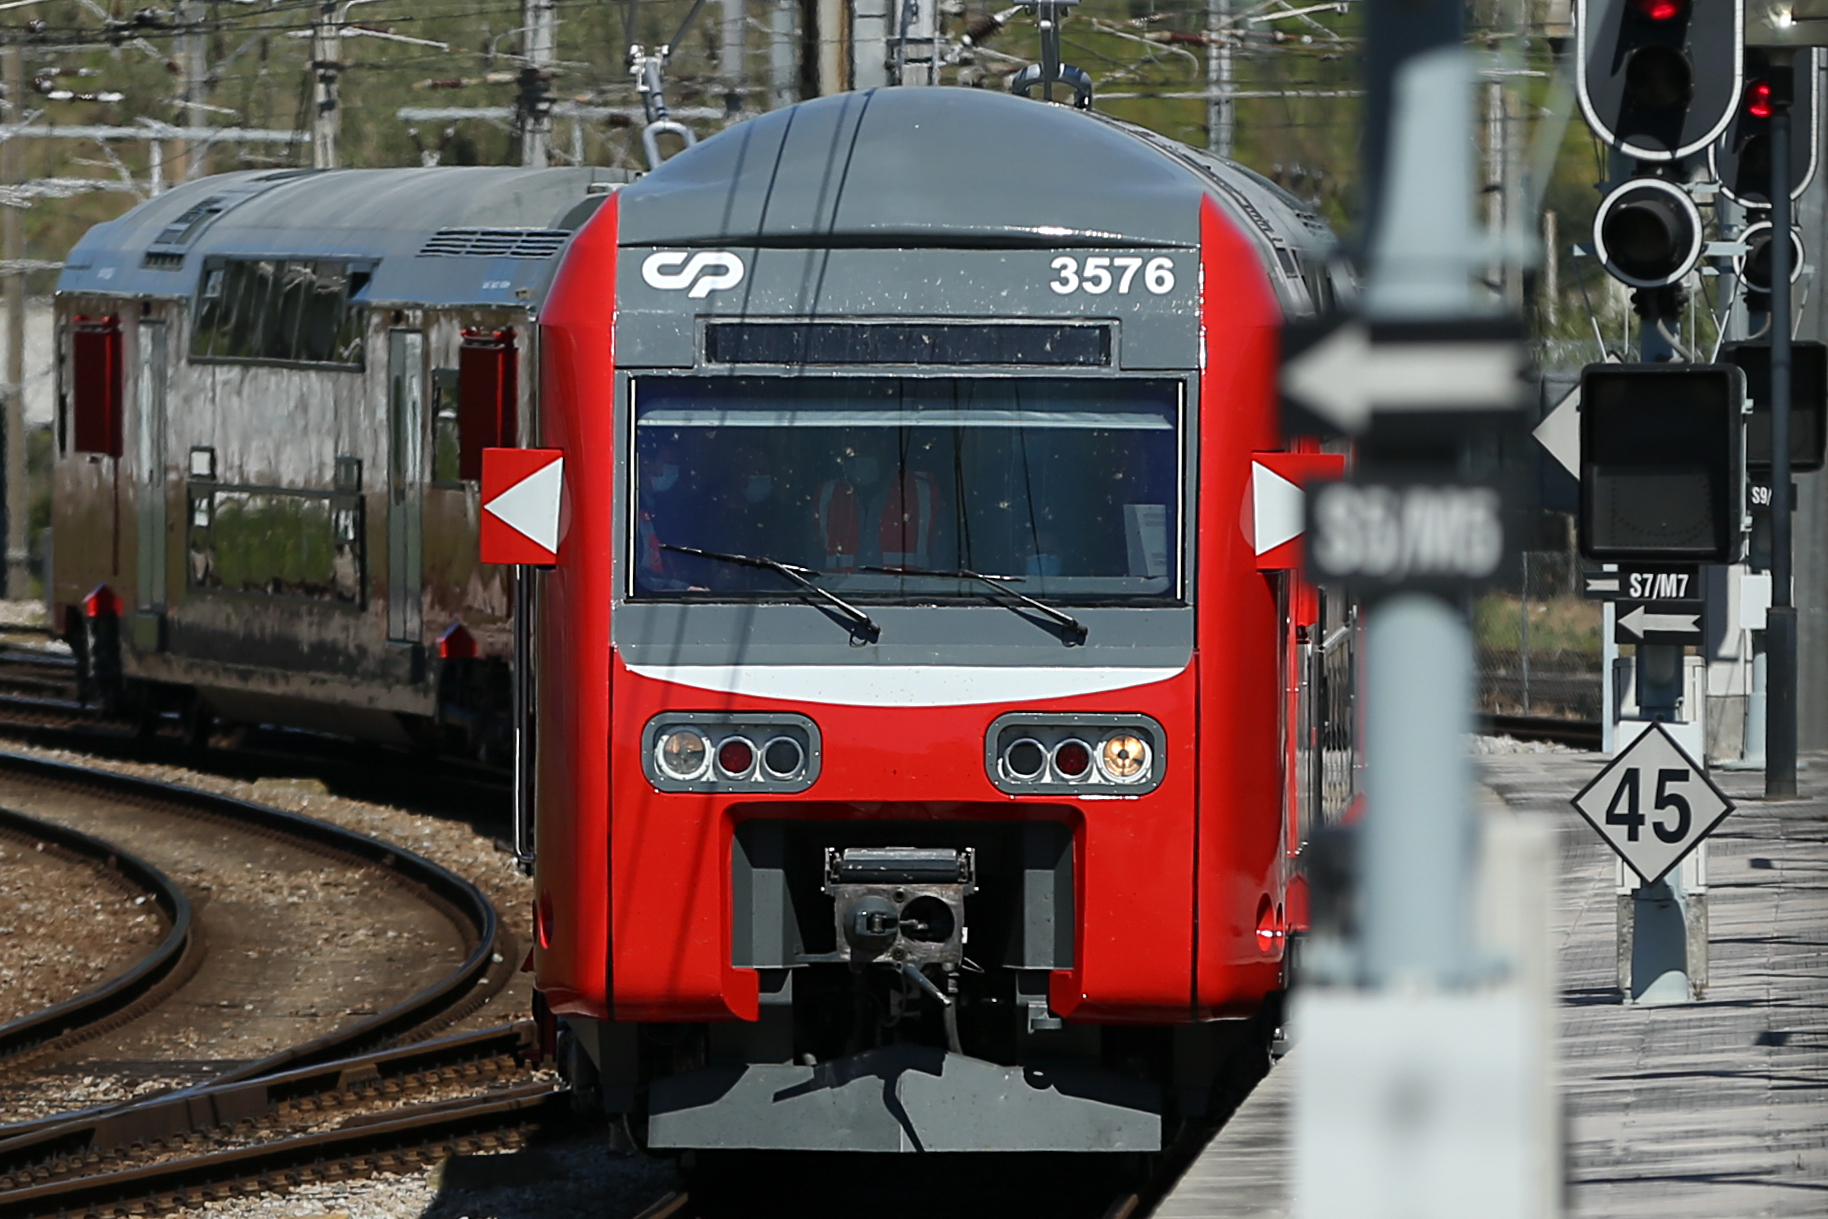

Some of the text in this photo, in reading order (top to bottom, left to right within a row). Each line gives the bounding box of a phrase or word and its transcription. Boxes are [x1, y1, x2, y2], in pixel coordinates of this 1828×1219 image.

[1050, 256, 1175, 294] 3576
[1751, 486, 1772, 506] S9/
[1629, 572, 1689, 600] S7/M7
[1605, 767, 1692, 844] 45
